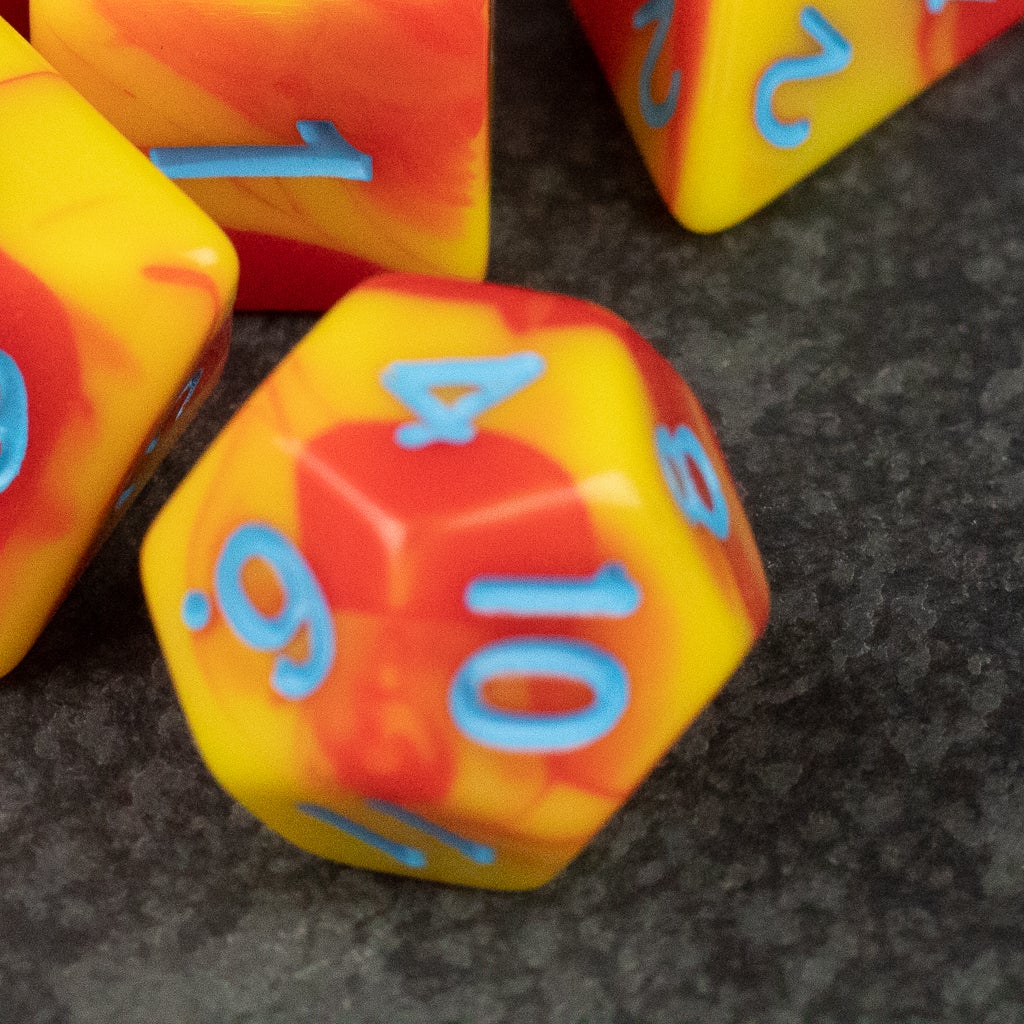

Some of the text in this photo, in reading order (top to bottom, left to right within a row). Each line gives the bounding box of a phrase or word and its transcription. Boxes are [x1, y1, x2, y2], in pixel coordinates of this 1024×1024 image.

[754, 5, 853, 149] 2
[149, 119, 374, 182] 1
[380, 352, 546, 449] 4
[655, 425, 730, 541] 8
[449, 562, 643, 752] 10
